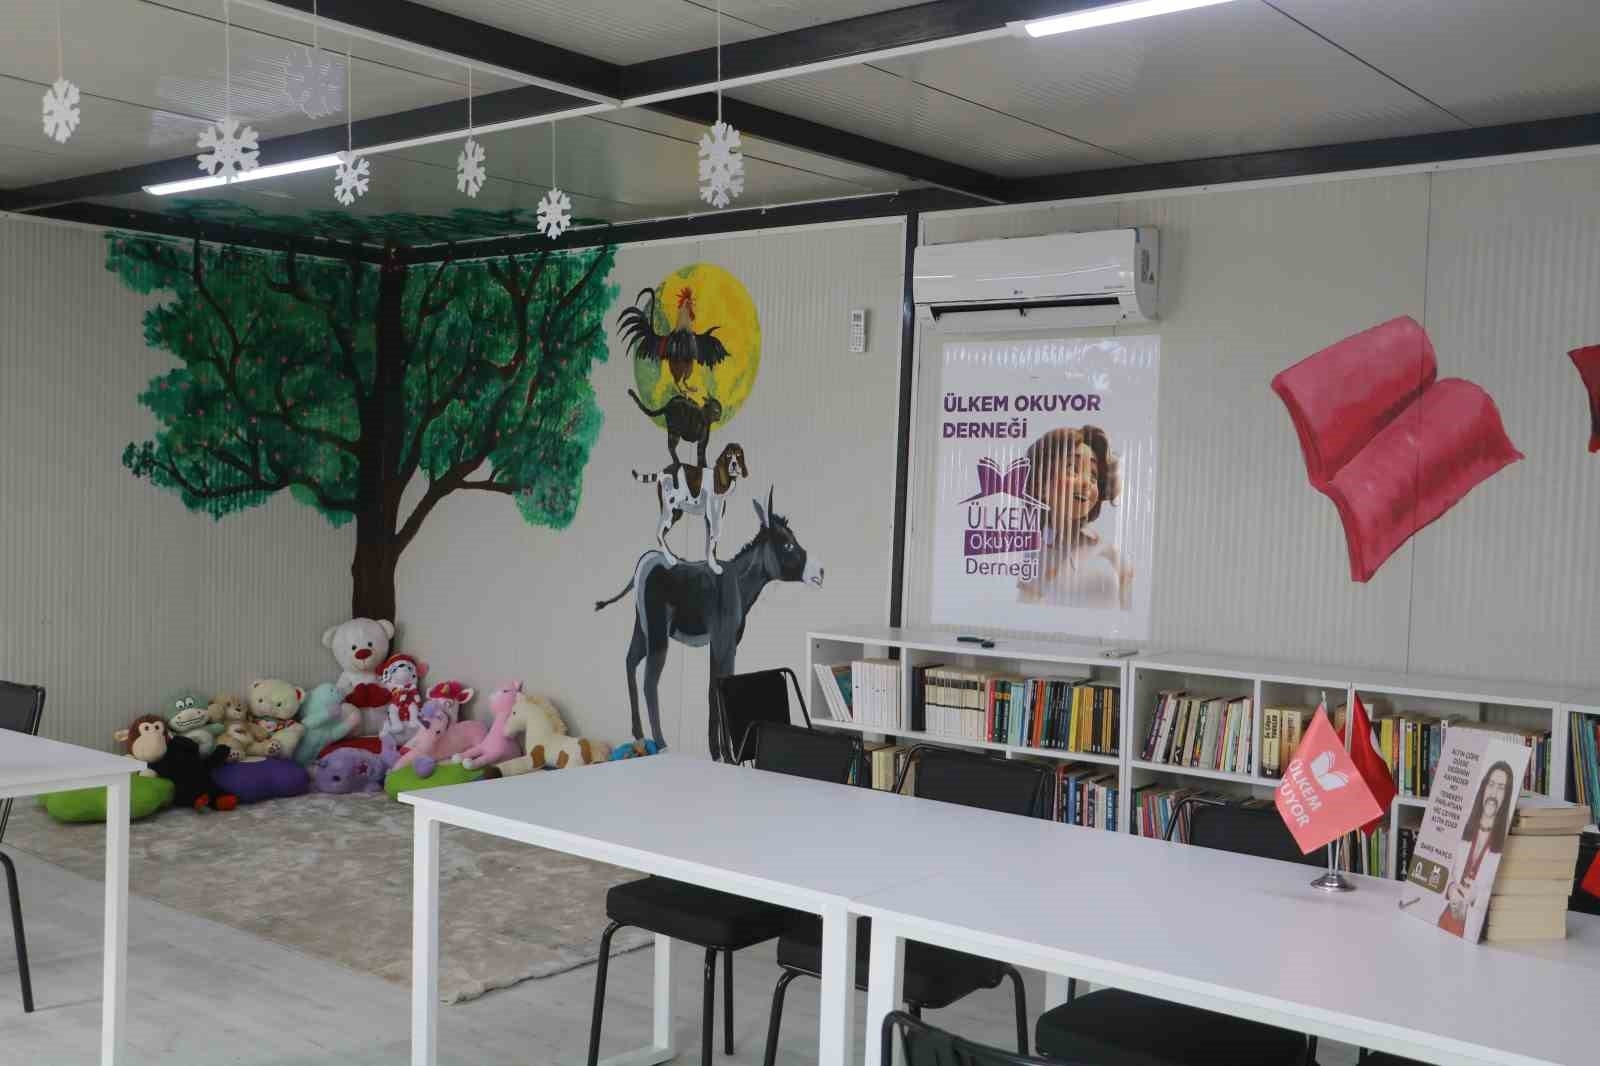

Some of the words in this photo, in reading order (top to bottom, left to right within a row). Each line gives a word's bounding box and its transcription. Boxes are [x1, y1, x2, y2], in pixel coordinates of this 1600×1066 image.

[943, 392, 1009, 412] ÜLKEM
[1014, 394, 1101, 412] OKUYOR
[942, 417, 1028, 438] DERNEĞİ
[967, 501, 1039, 531] ÜLKEM
[970, 531, 1032, 552] Okuyor
[965, 557, 1037, 581] Derneği
